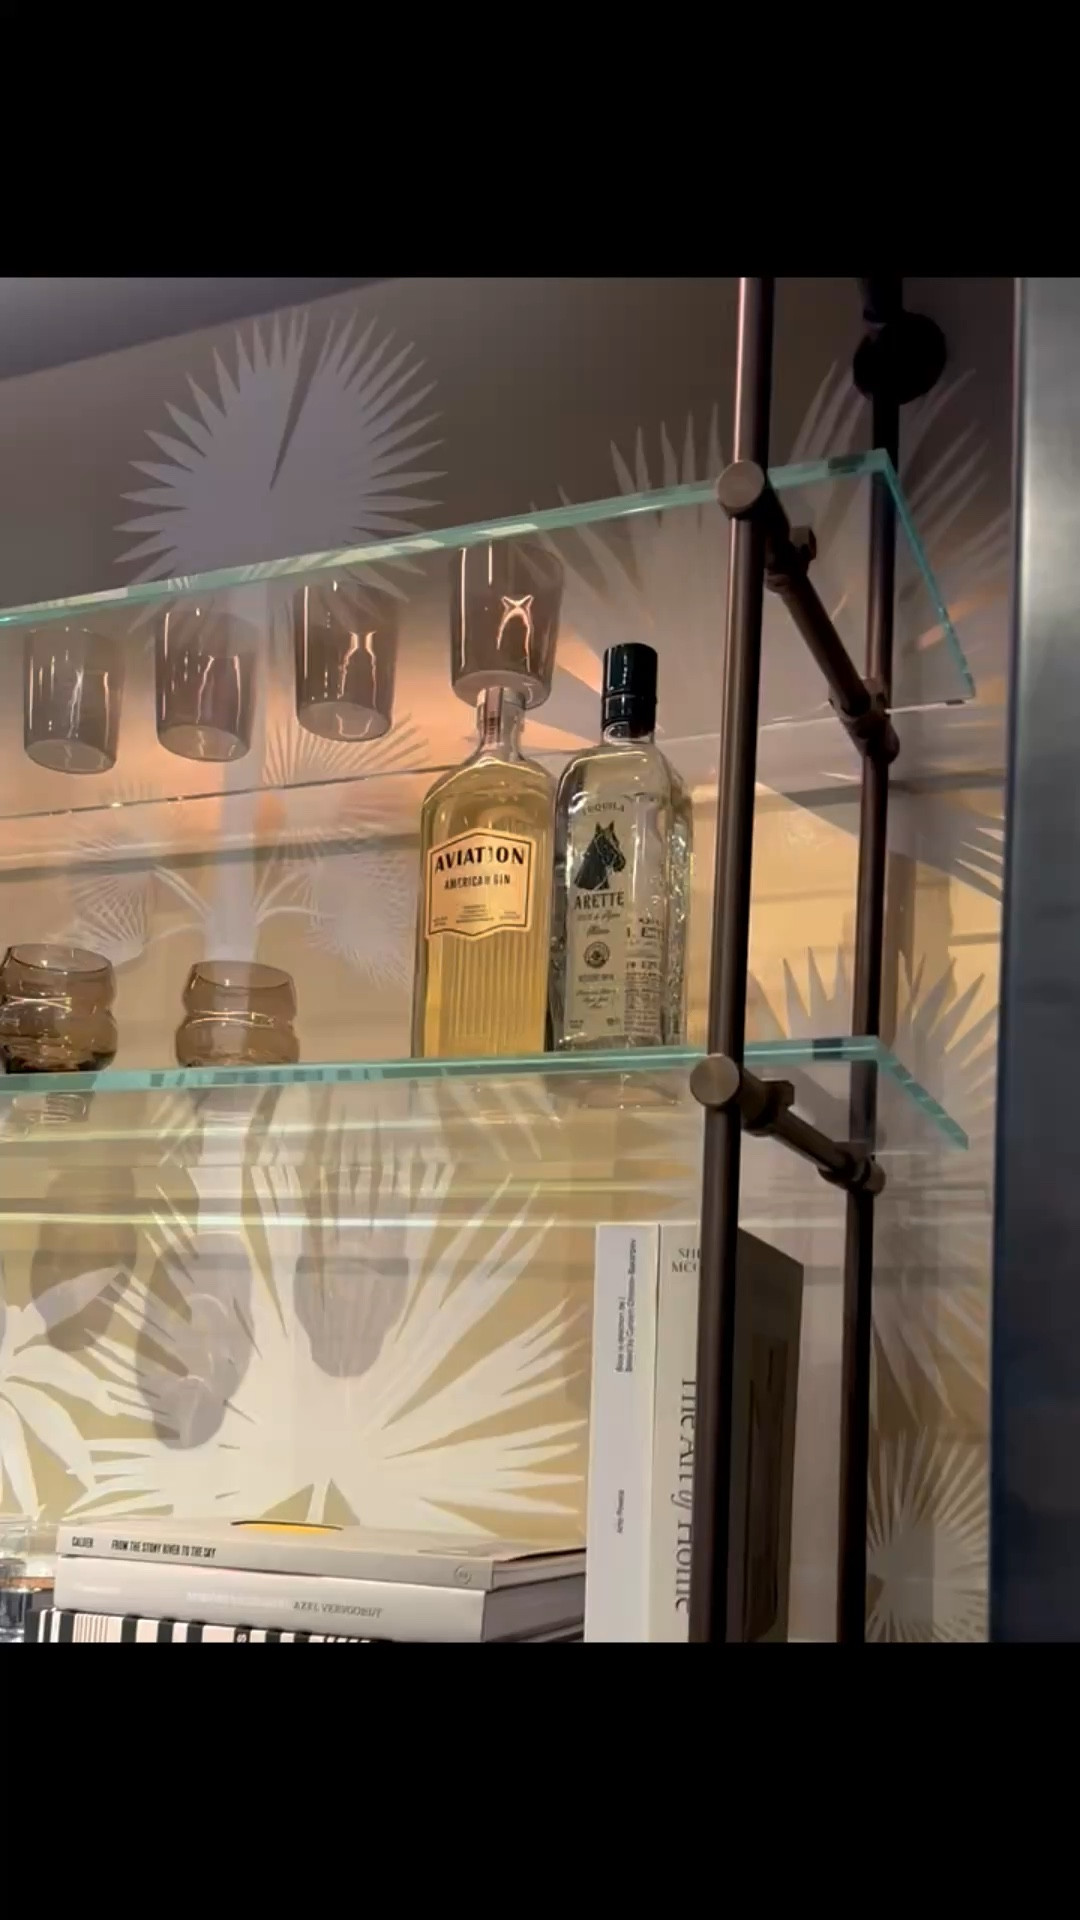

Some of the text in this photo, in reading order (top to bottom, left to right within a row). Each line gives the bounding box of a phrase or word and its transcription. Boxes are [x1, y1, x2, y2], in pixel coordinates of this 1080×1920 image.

[434, 846, 524, 874] AVIATION
[444, 873, 511, 890] AMERICAN GIN
[574, 891, 624, 910] ARETTE
[111, 1539, 128, 1551] FROM
[130, 1540, 141, 1552] THE
[142, 1541, 161, 1554] STONY
[162, 1543, 180, 1555] RIVER
[181, 1545, 189, 1556] TO
[191, 1546, 203, 1557] THE
